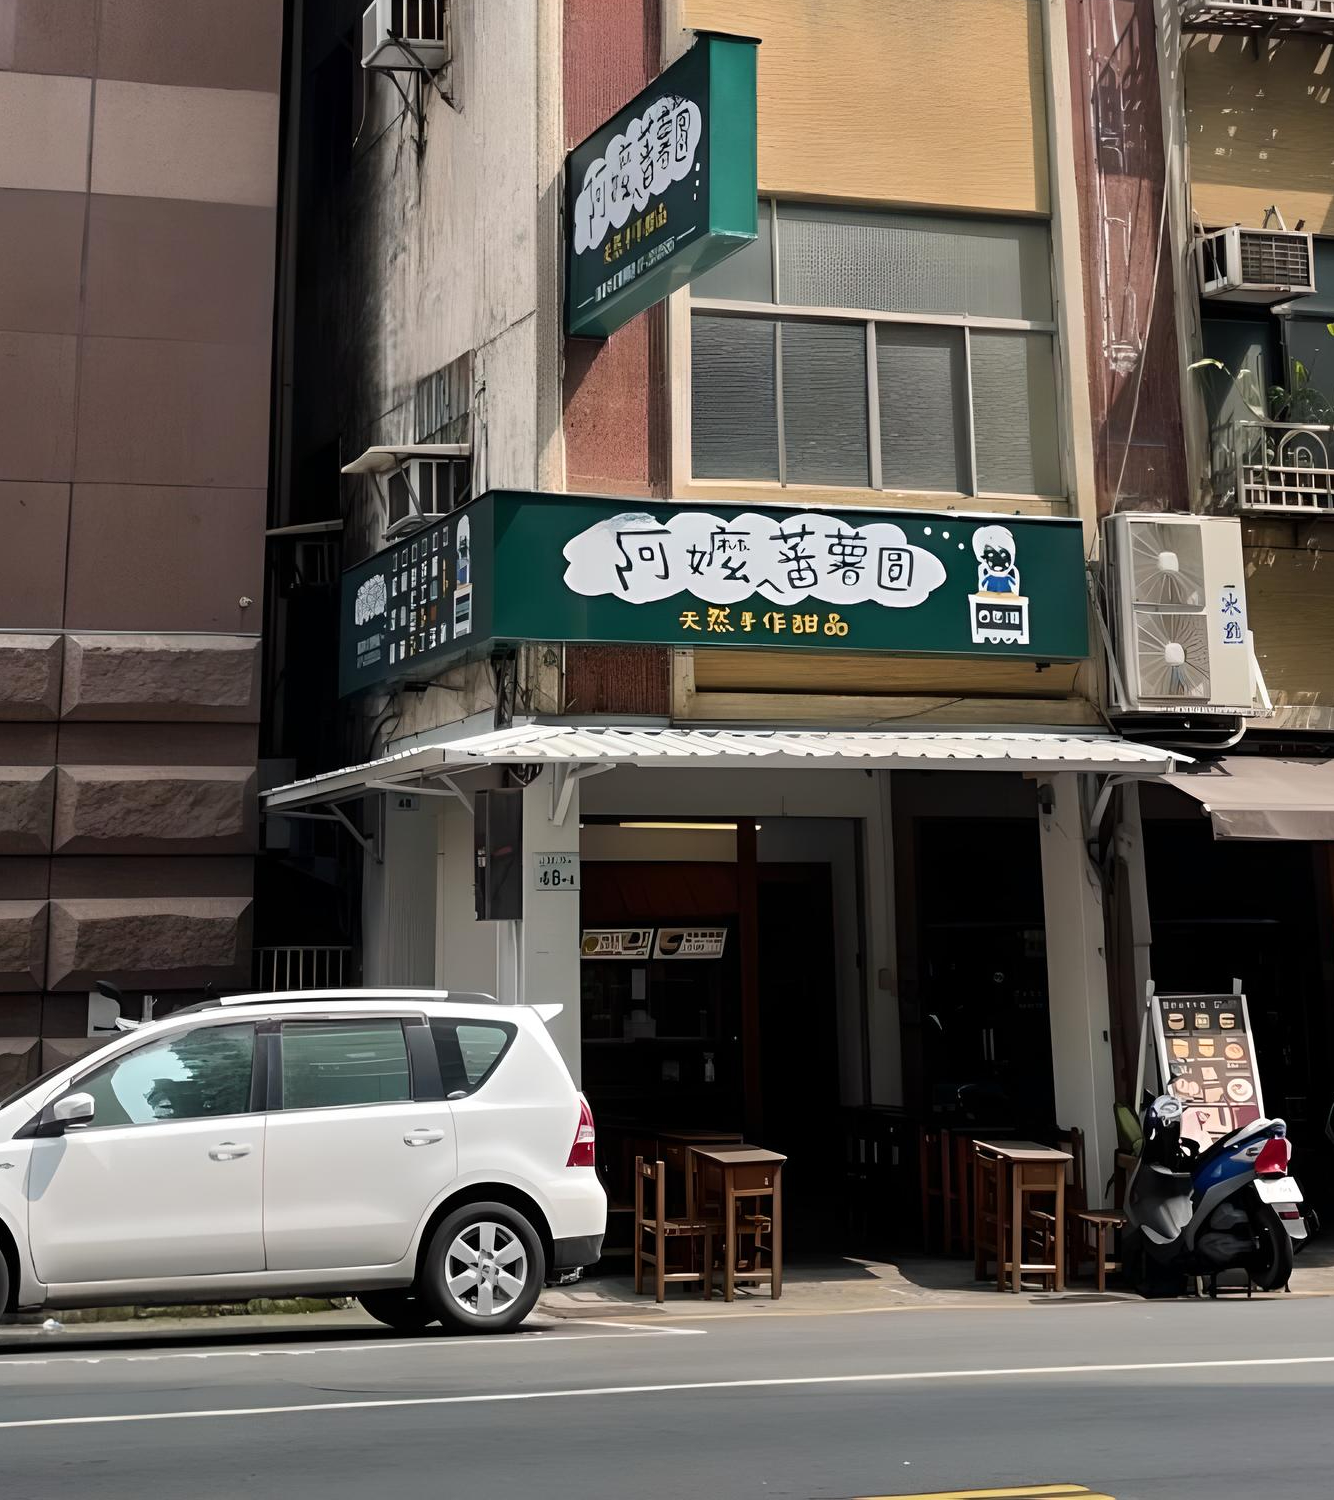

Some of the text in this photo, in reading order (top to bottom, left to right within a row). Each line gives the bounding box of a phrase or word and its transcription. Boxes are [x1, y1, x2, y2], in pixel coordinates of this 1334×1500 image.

[678, 606, 849, 637] 天然手作甜品
